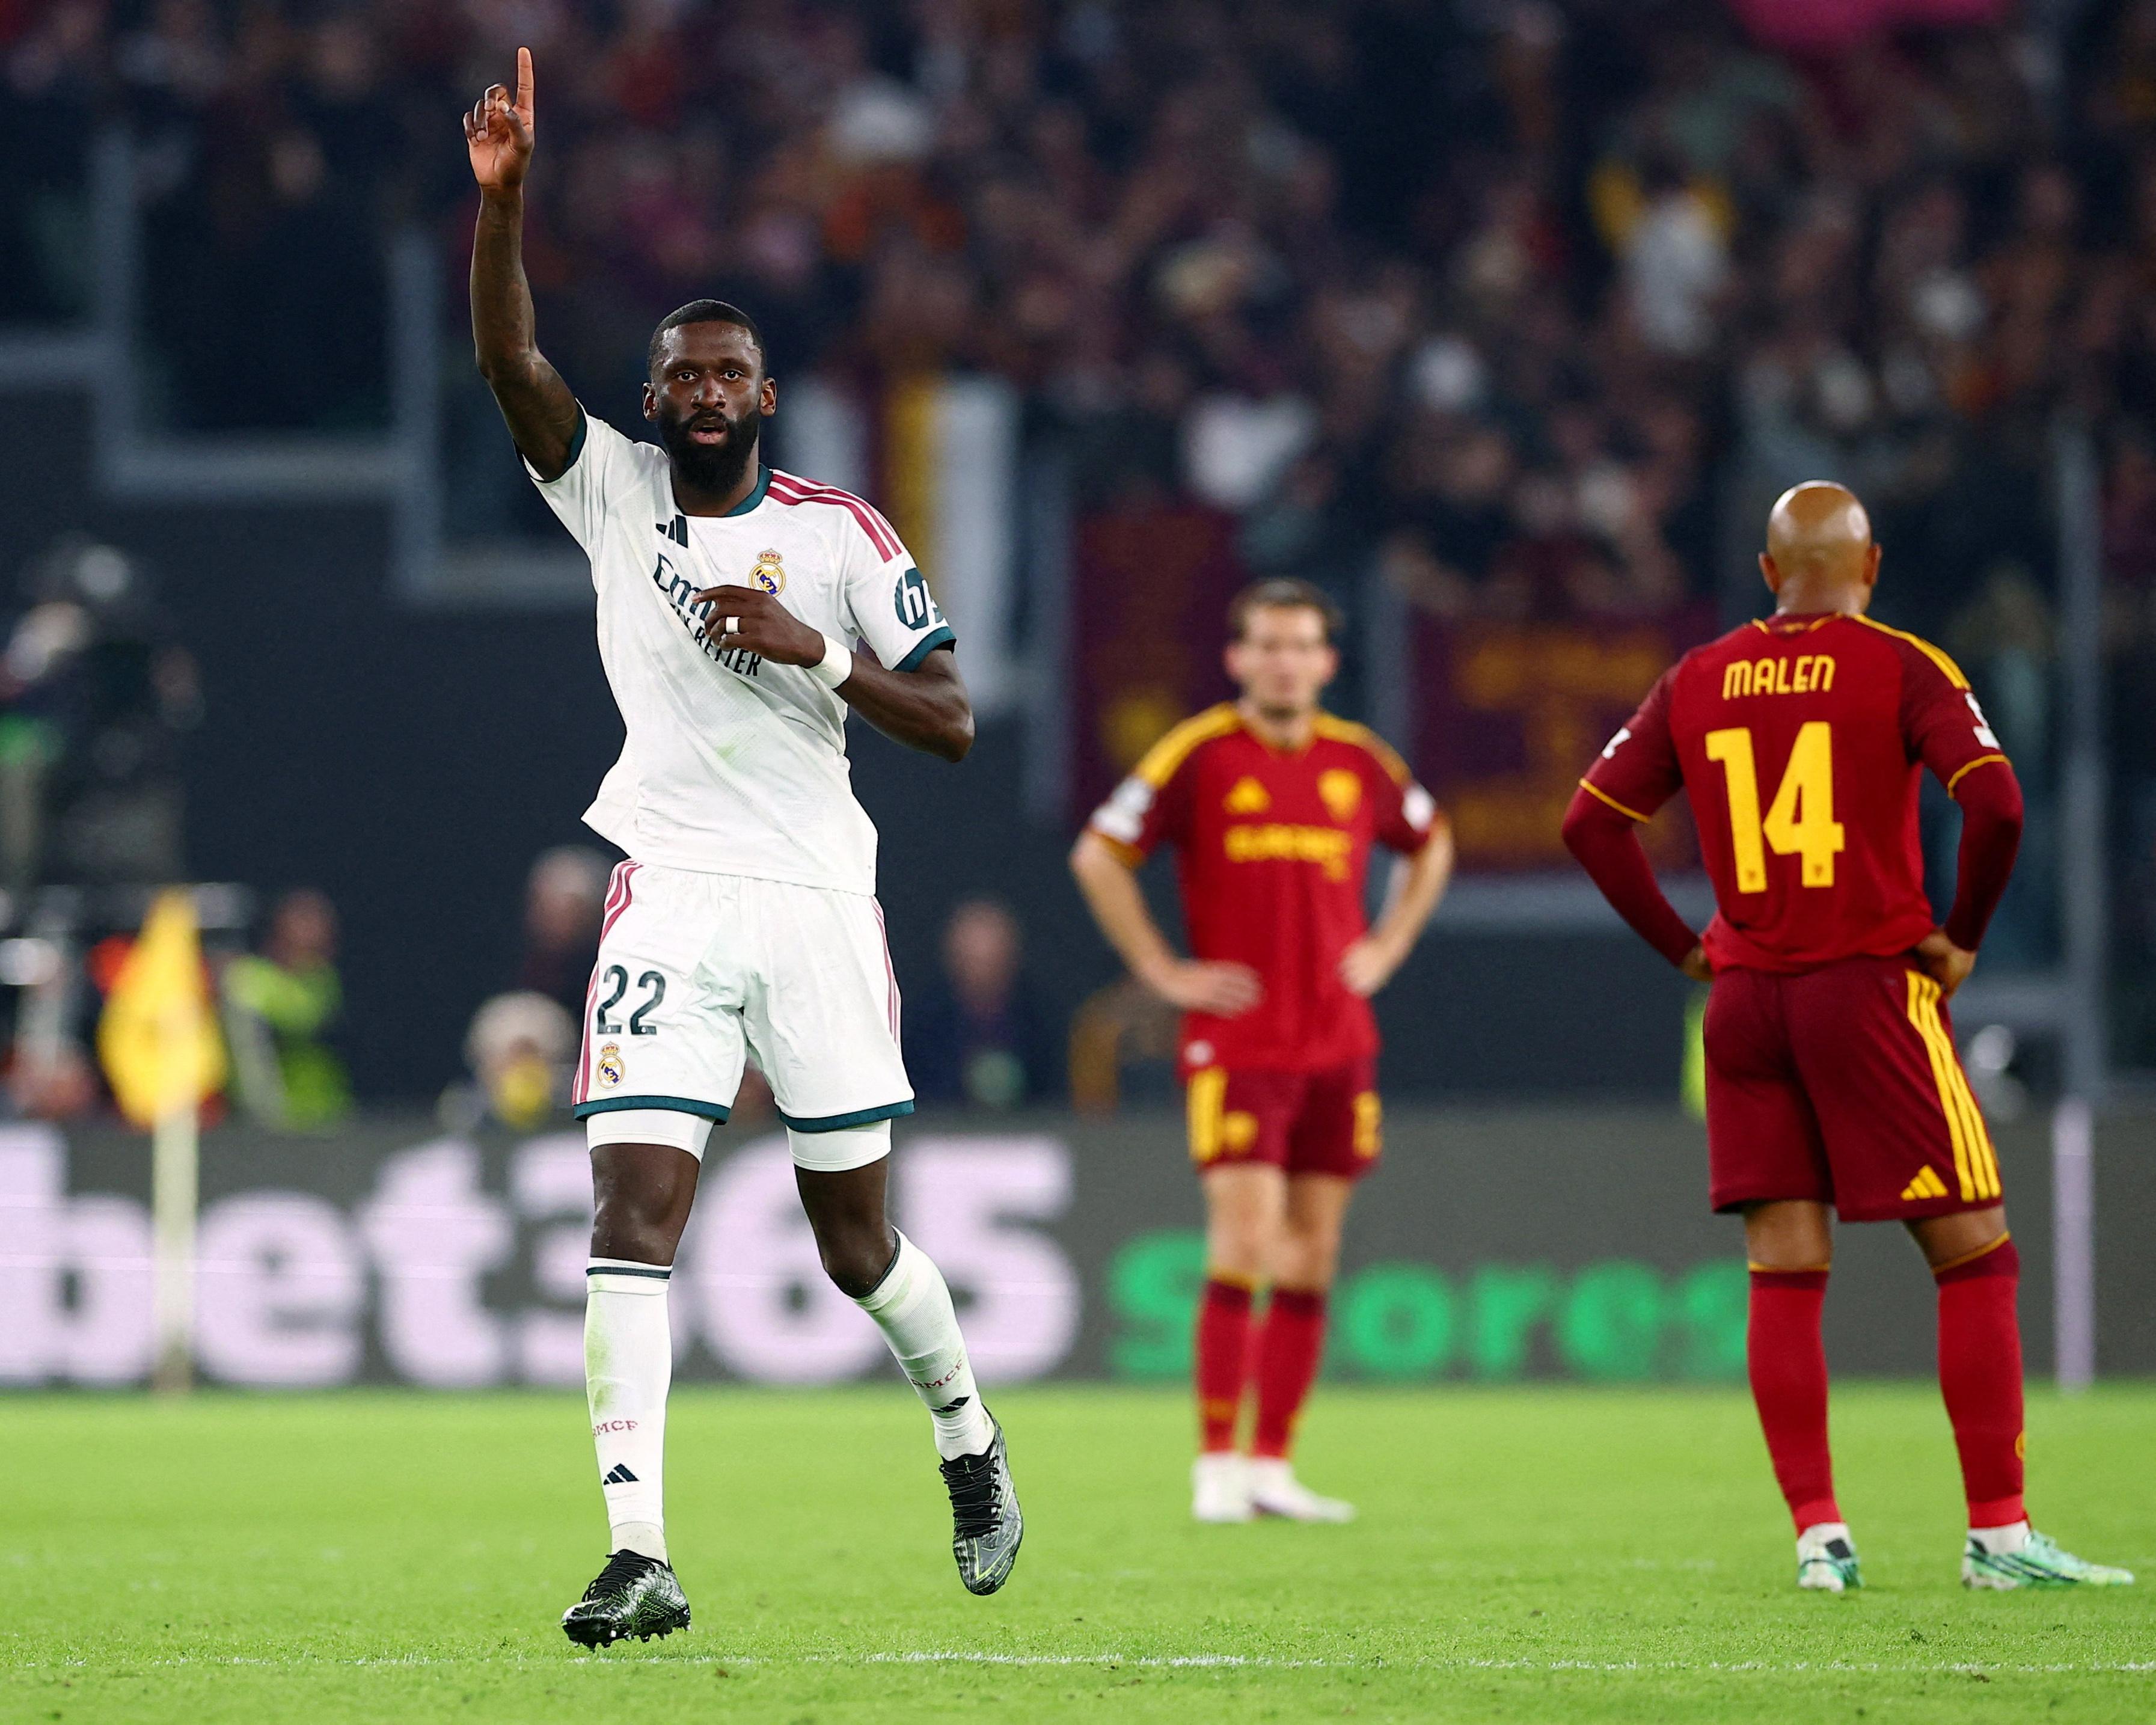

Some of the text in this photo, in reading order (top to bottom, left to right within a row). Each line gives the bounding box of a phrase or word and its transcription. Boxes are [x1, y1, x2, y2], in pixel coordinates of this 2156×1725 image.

[1721, 654, 1836, 701] MALEN
[1705, 722, 1845, 894] 14
[596, 964, 667, 1036] 22
[1104, 1227, 1751, 1379] Sores
